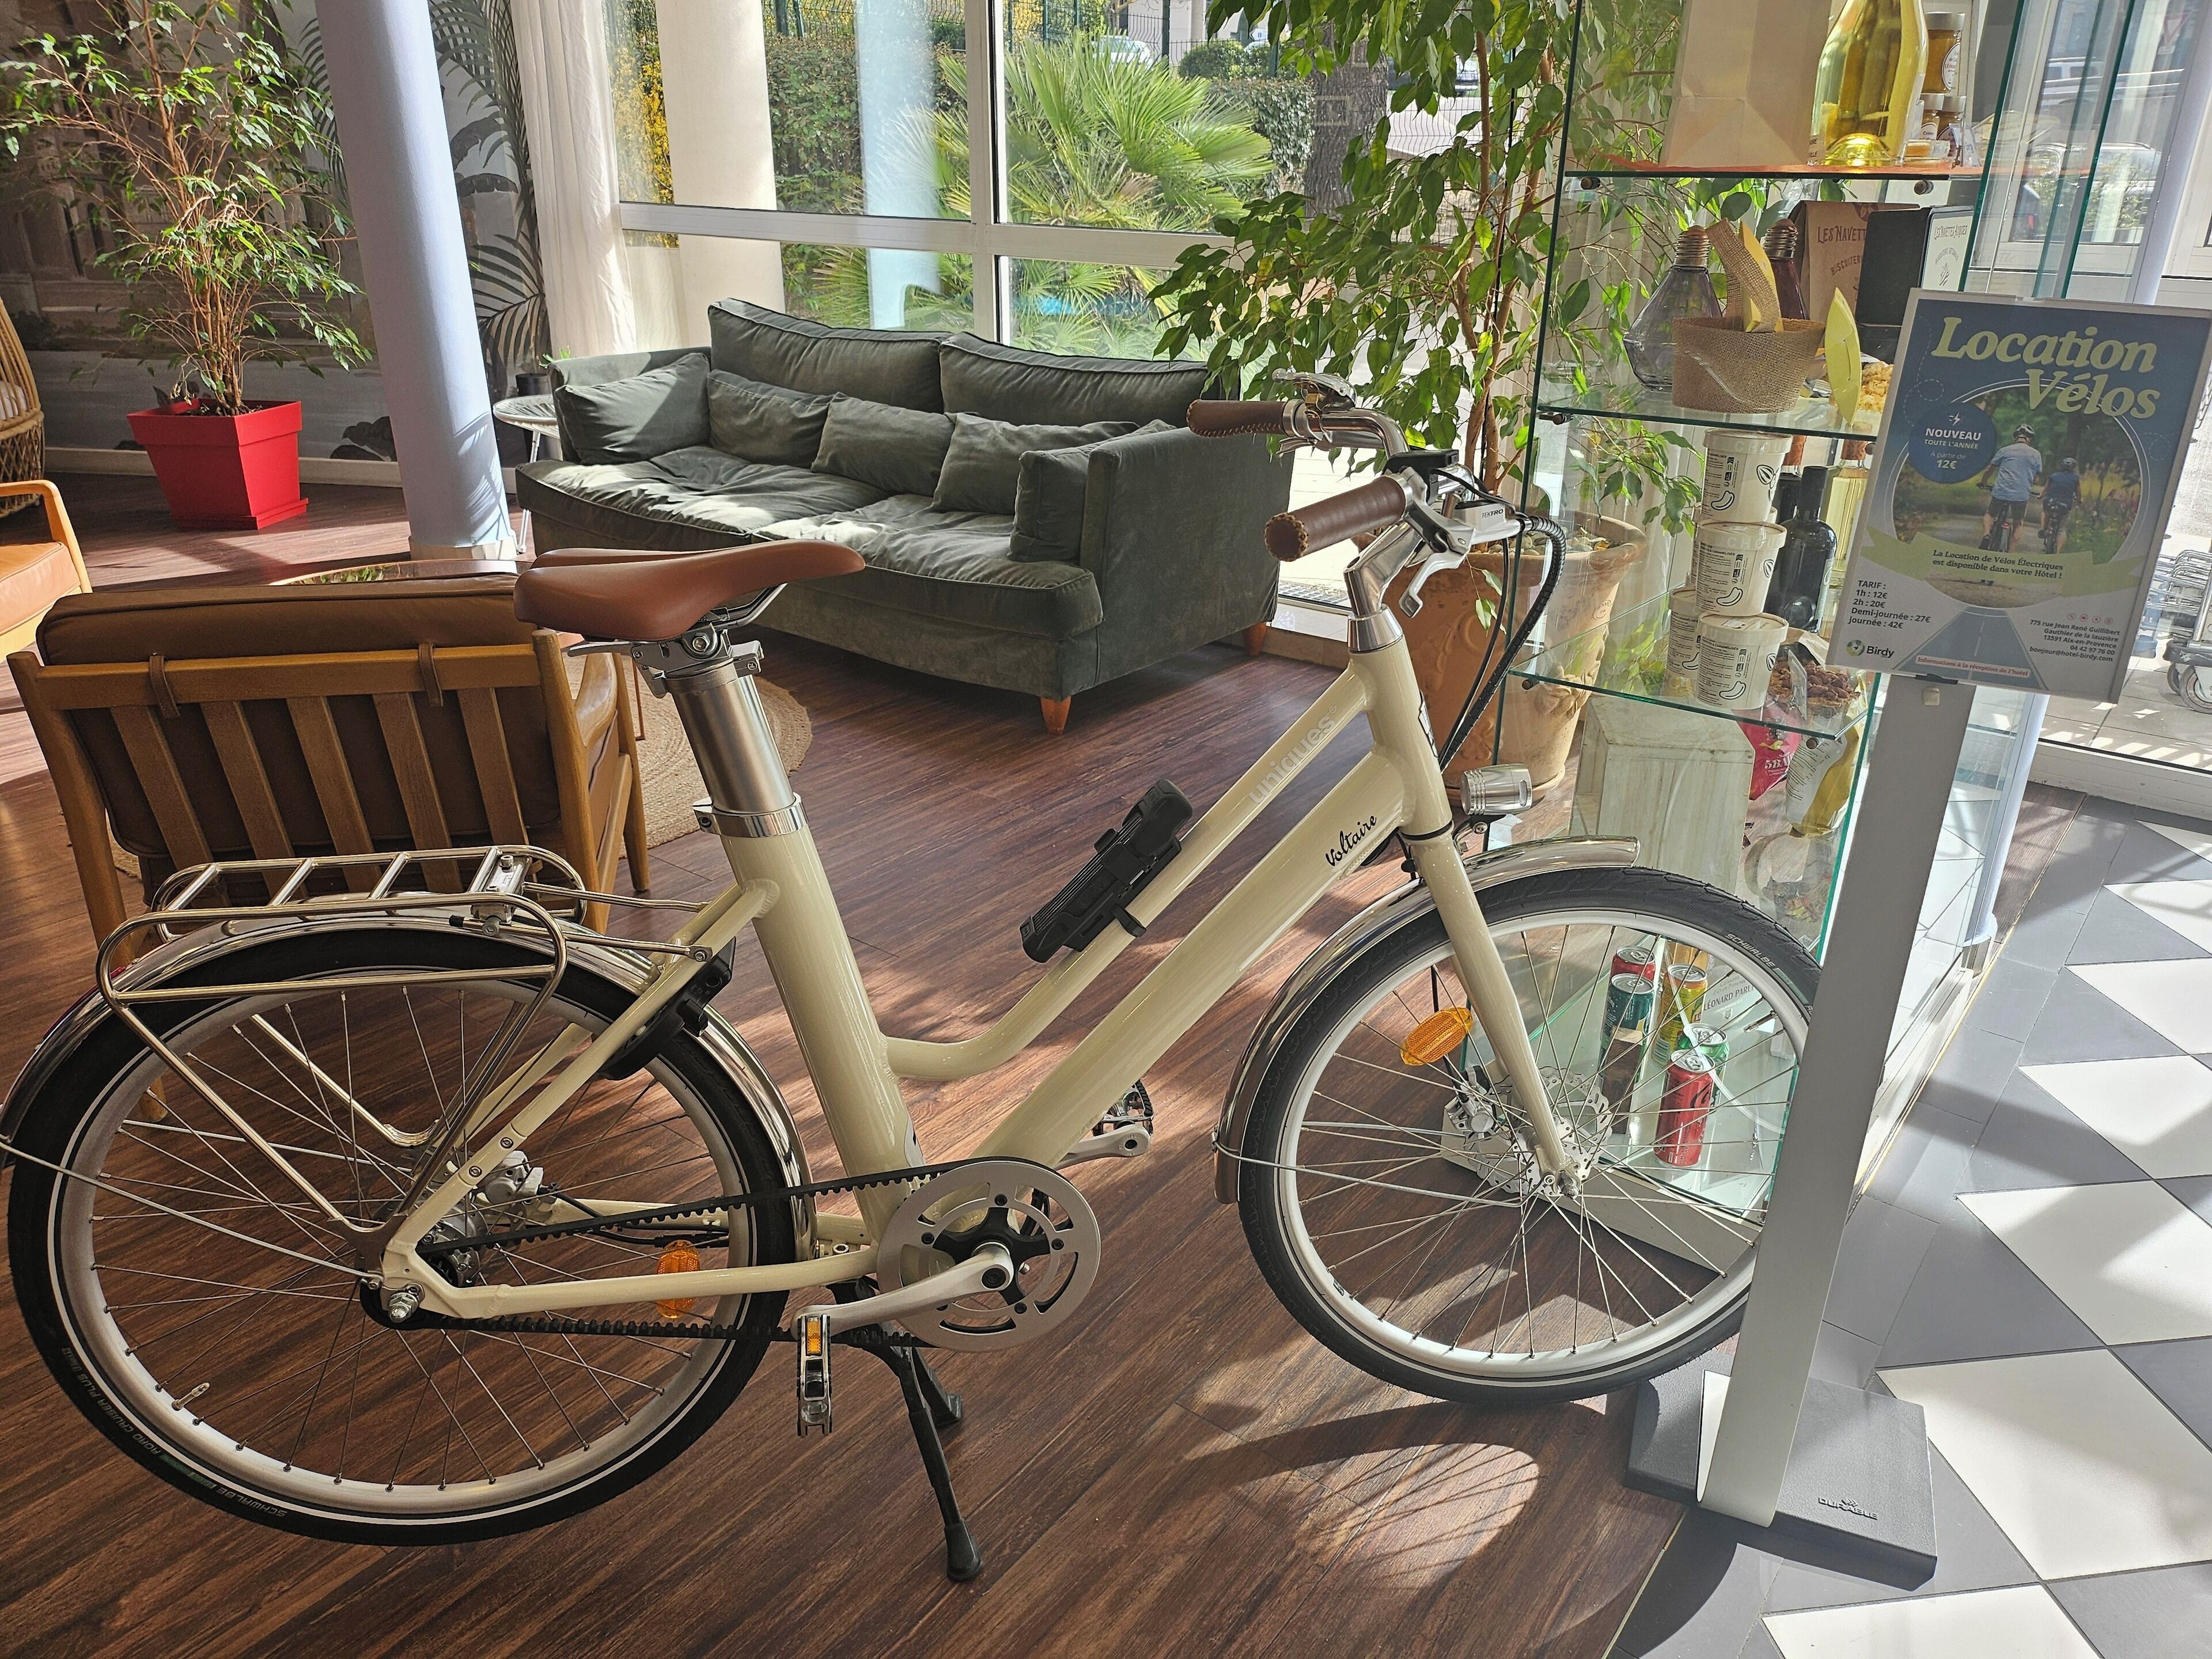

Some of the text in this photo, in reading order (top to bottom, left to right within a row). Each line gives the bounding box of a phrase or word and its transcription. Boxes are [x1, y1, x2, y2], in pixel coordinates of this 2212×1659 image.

[1818, 226, 1834, 244] LES
[1830, 255, 1862, 276] BISCUITER
[1930, 317, 2157, 373] Location
[2025, 369, 2160, 419] Vélos
[1925, 428, 1982, 441] NOUVEAU
[1948, 441, 1979, 449] L'ANNÉE
[1937, 452, 1955, 460] partir
[1937, 460, 1957, 469] 12€
[1482, 509, 1503, 518] TEKTRO
[1945, 550, 1979, 561] Location
[1994, 556, 2015, 565] Vélos
[2017, 557, 2063, 571] Électriques
[1946, 560, 1988, 571] disponible
[1990, 565, 2009, 573] dans
[2012, 568, 2032, 576] votre
[2034, 570, 2057, 578] Hôtel
[1858, 580, 1882, 589] TARIF
[1870, 600, 1886, 608] 20€
[1848, 616, 1882, 626] journée
[1888, 621, 1904, 629] 42€
[1851, 607, 1909, 620] Demi-journée
[1915, 615, 1931, 623] 27€
[2044, 628, 2073, 637] Gauthier
[2063, 637, 2117, 649] Aix-en-Provence
[1866, 646, 1895, 658] Birdy
[2029, 646, 2113, 662] bonjour@hotel-birdy.com
[1917, 657, 1956, 667] Informations
[1969, 664, 1998, 672] réception
[1325, 815, 1378, 866] Voltaire
[1725, 933, 1776, 969] SCHWALBE
[77, 1373, 161, 1455] ROAD CRUISER PLUS
[217, 1486, 287, 1517] SCHWALBE
[1818, 1497, 1879, 1521] DURABLE
